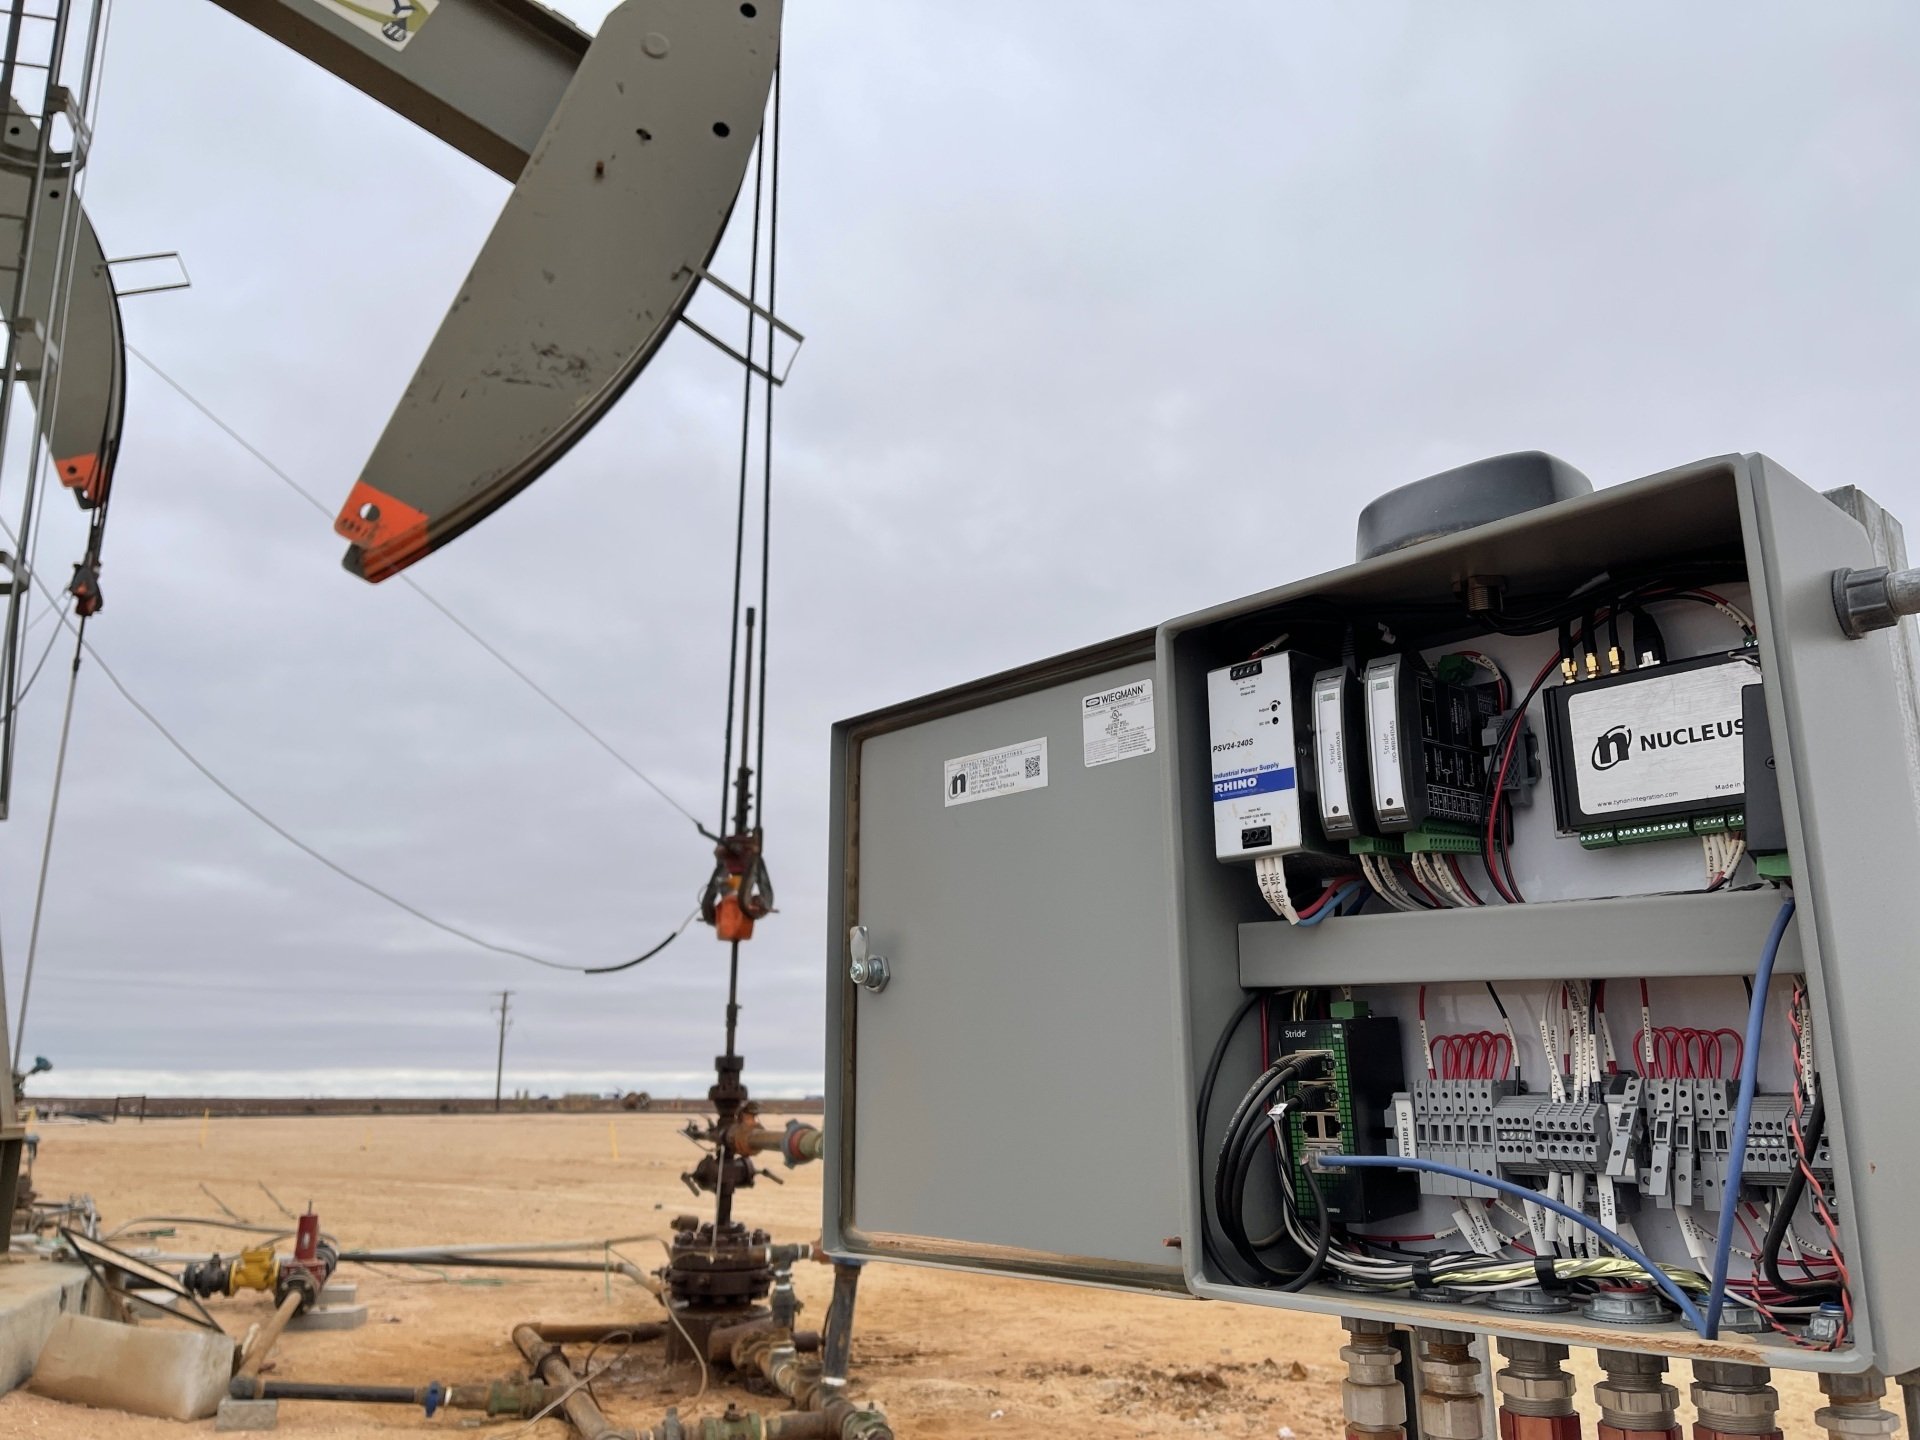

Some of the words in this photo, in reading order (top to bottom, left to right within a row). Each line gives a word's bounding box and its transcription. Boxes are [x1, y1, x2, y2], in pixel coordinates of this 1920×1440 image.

[1101, 684, 1144, 704] WIEGMANN
[1640, 718, 1745, 752] NUCLEUS
[1213, 738, 1254, 752] PSV24-240S
[1213, 769, 1239, 779] Industrial
[1259, 762, 1280, 770] Supply
[1214, 777, 1257, 793] RHINO
[1284, 1029, 1306, 1038] Stride
[1541, 1025, 1555, 1071] NUCLEUS
